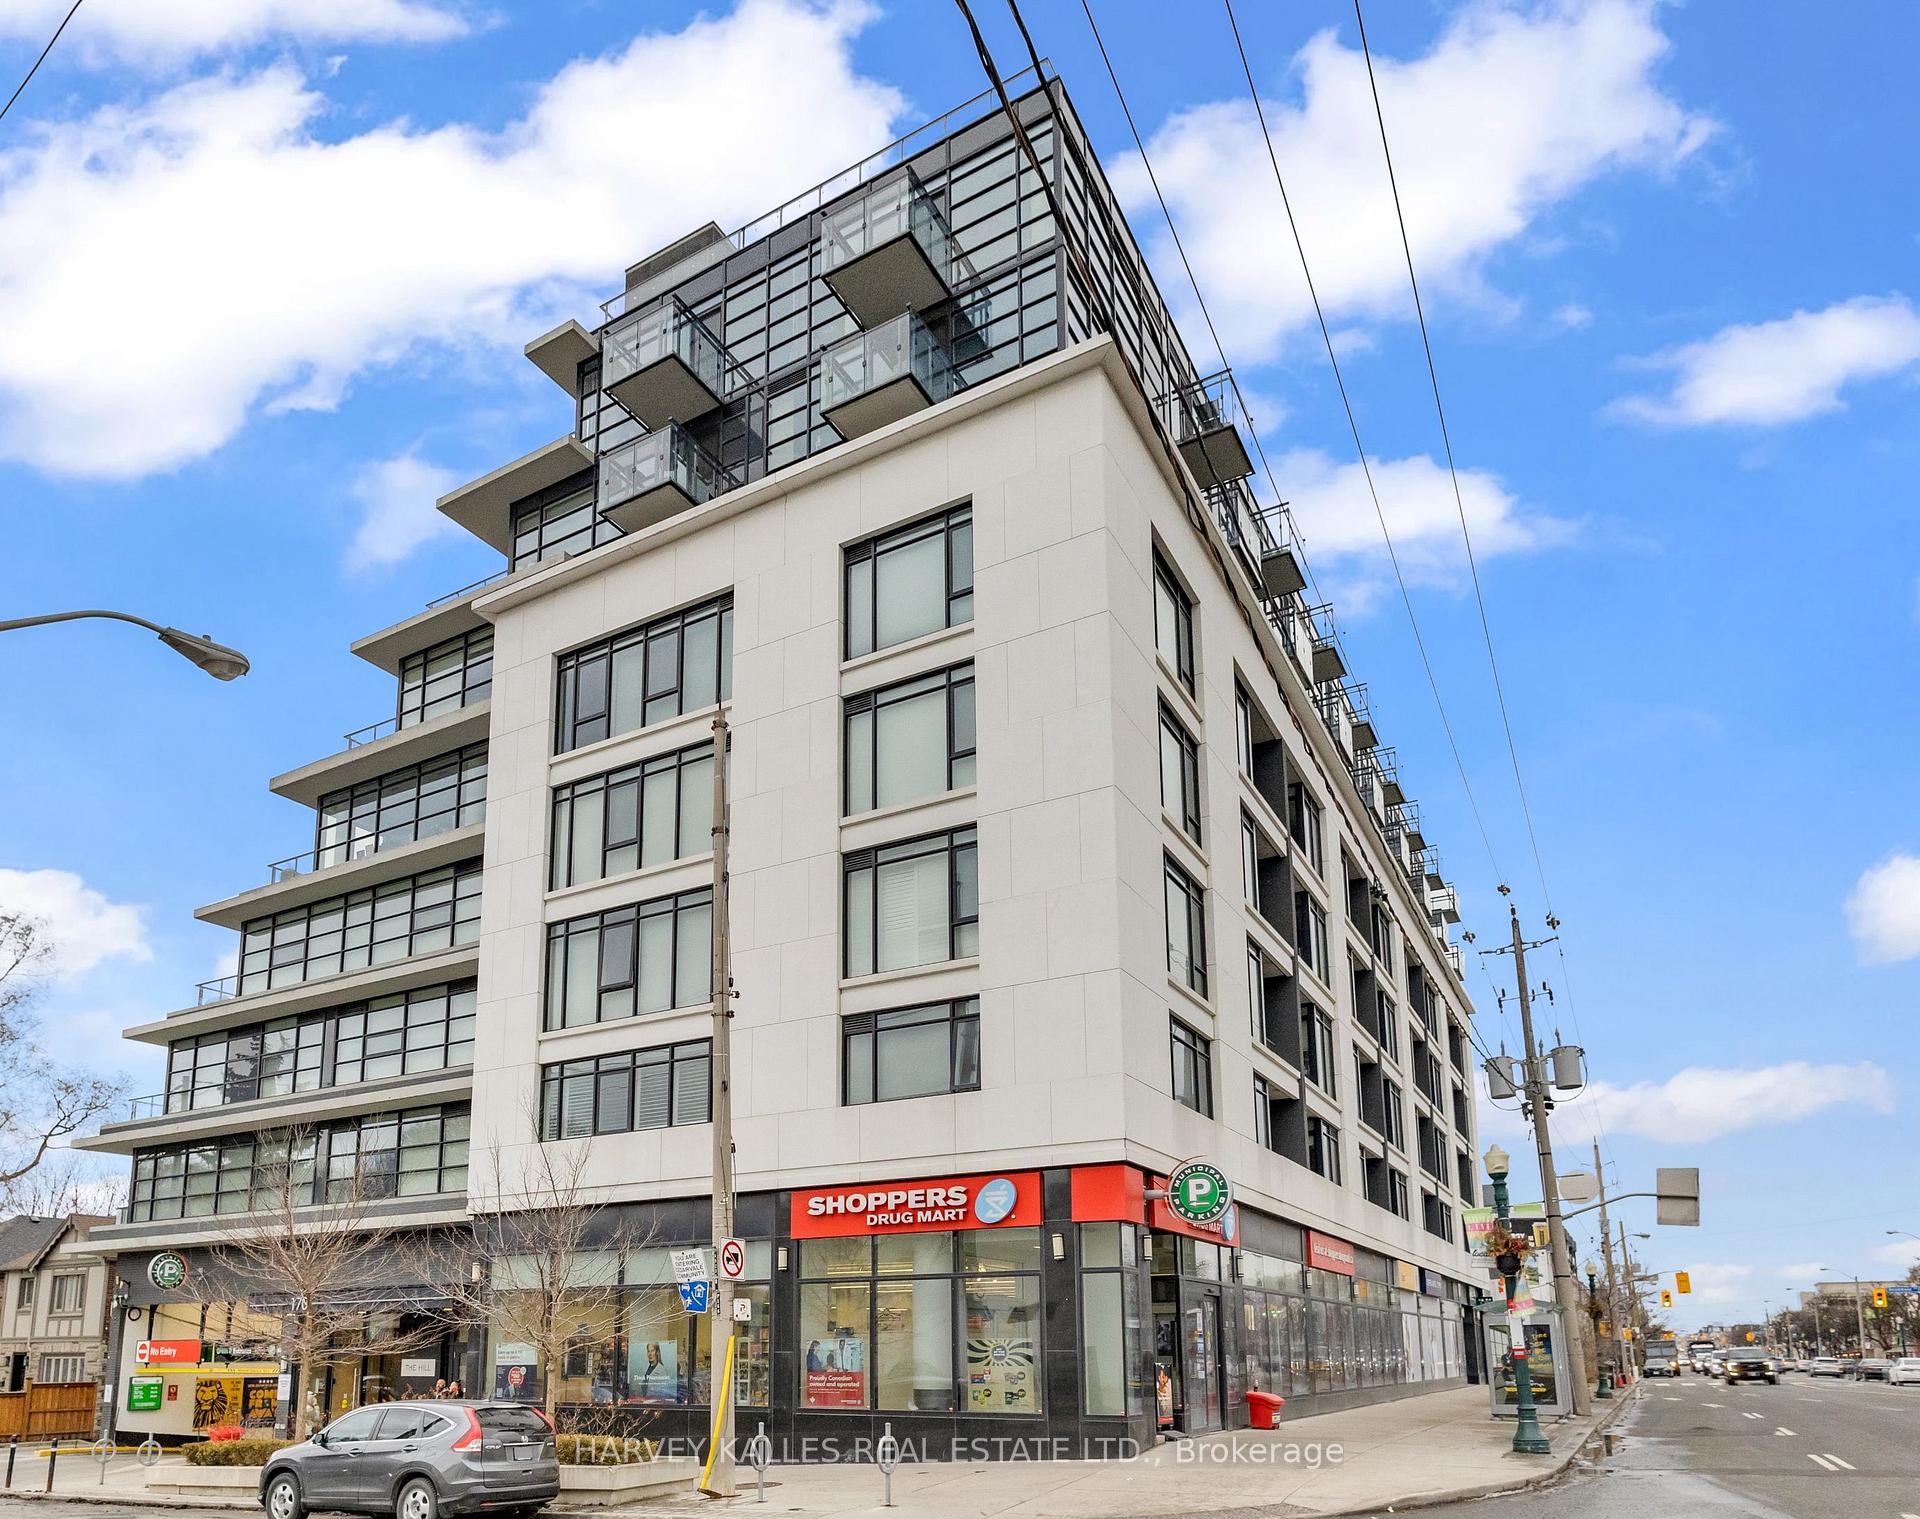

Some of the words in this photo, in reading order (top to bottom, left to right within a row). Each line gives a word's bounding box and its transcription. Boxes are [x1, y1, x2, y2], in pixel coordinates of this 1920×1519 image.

[1174, 1165, 1224, 1188] MUNICIPAL
[1188, 1178, 1211, 1202] P
[807, 1185, 968, 1216] SHOPPERS
[1173, 1196, 1226, 1220] PARKING
[866, 1212, 914, 1226] DRUG
[917, 1208, 967, 1224] MART
[164, 1263, 178, 1277] P
[150, 1347, 159, 1356] No
[160, 1346, 177, 1358] Entry
[405, 1364, 417, 1372] THE
[418, 1364, 431, 1372] HILL
